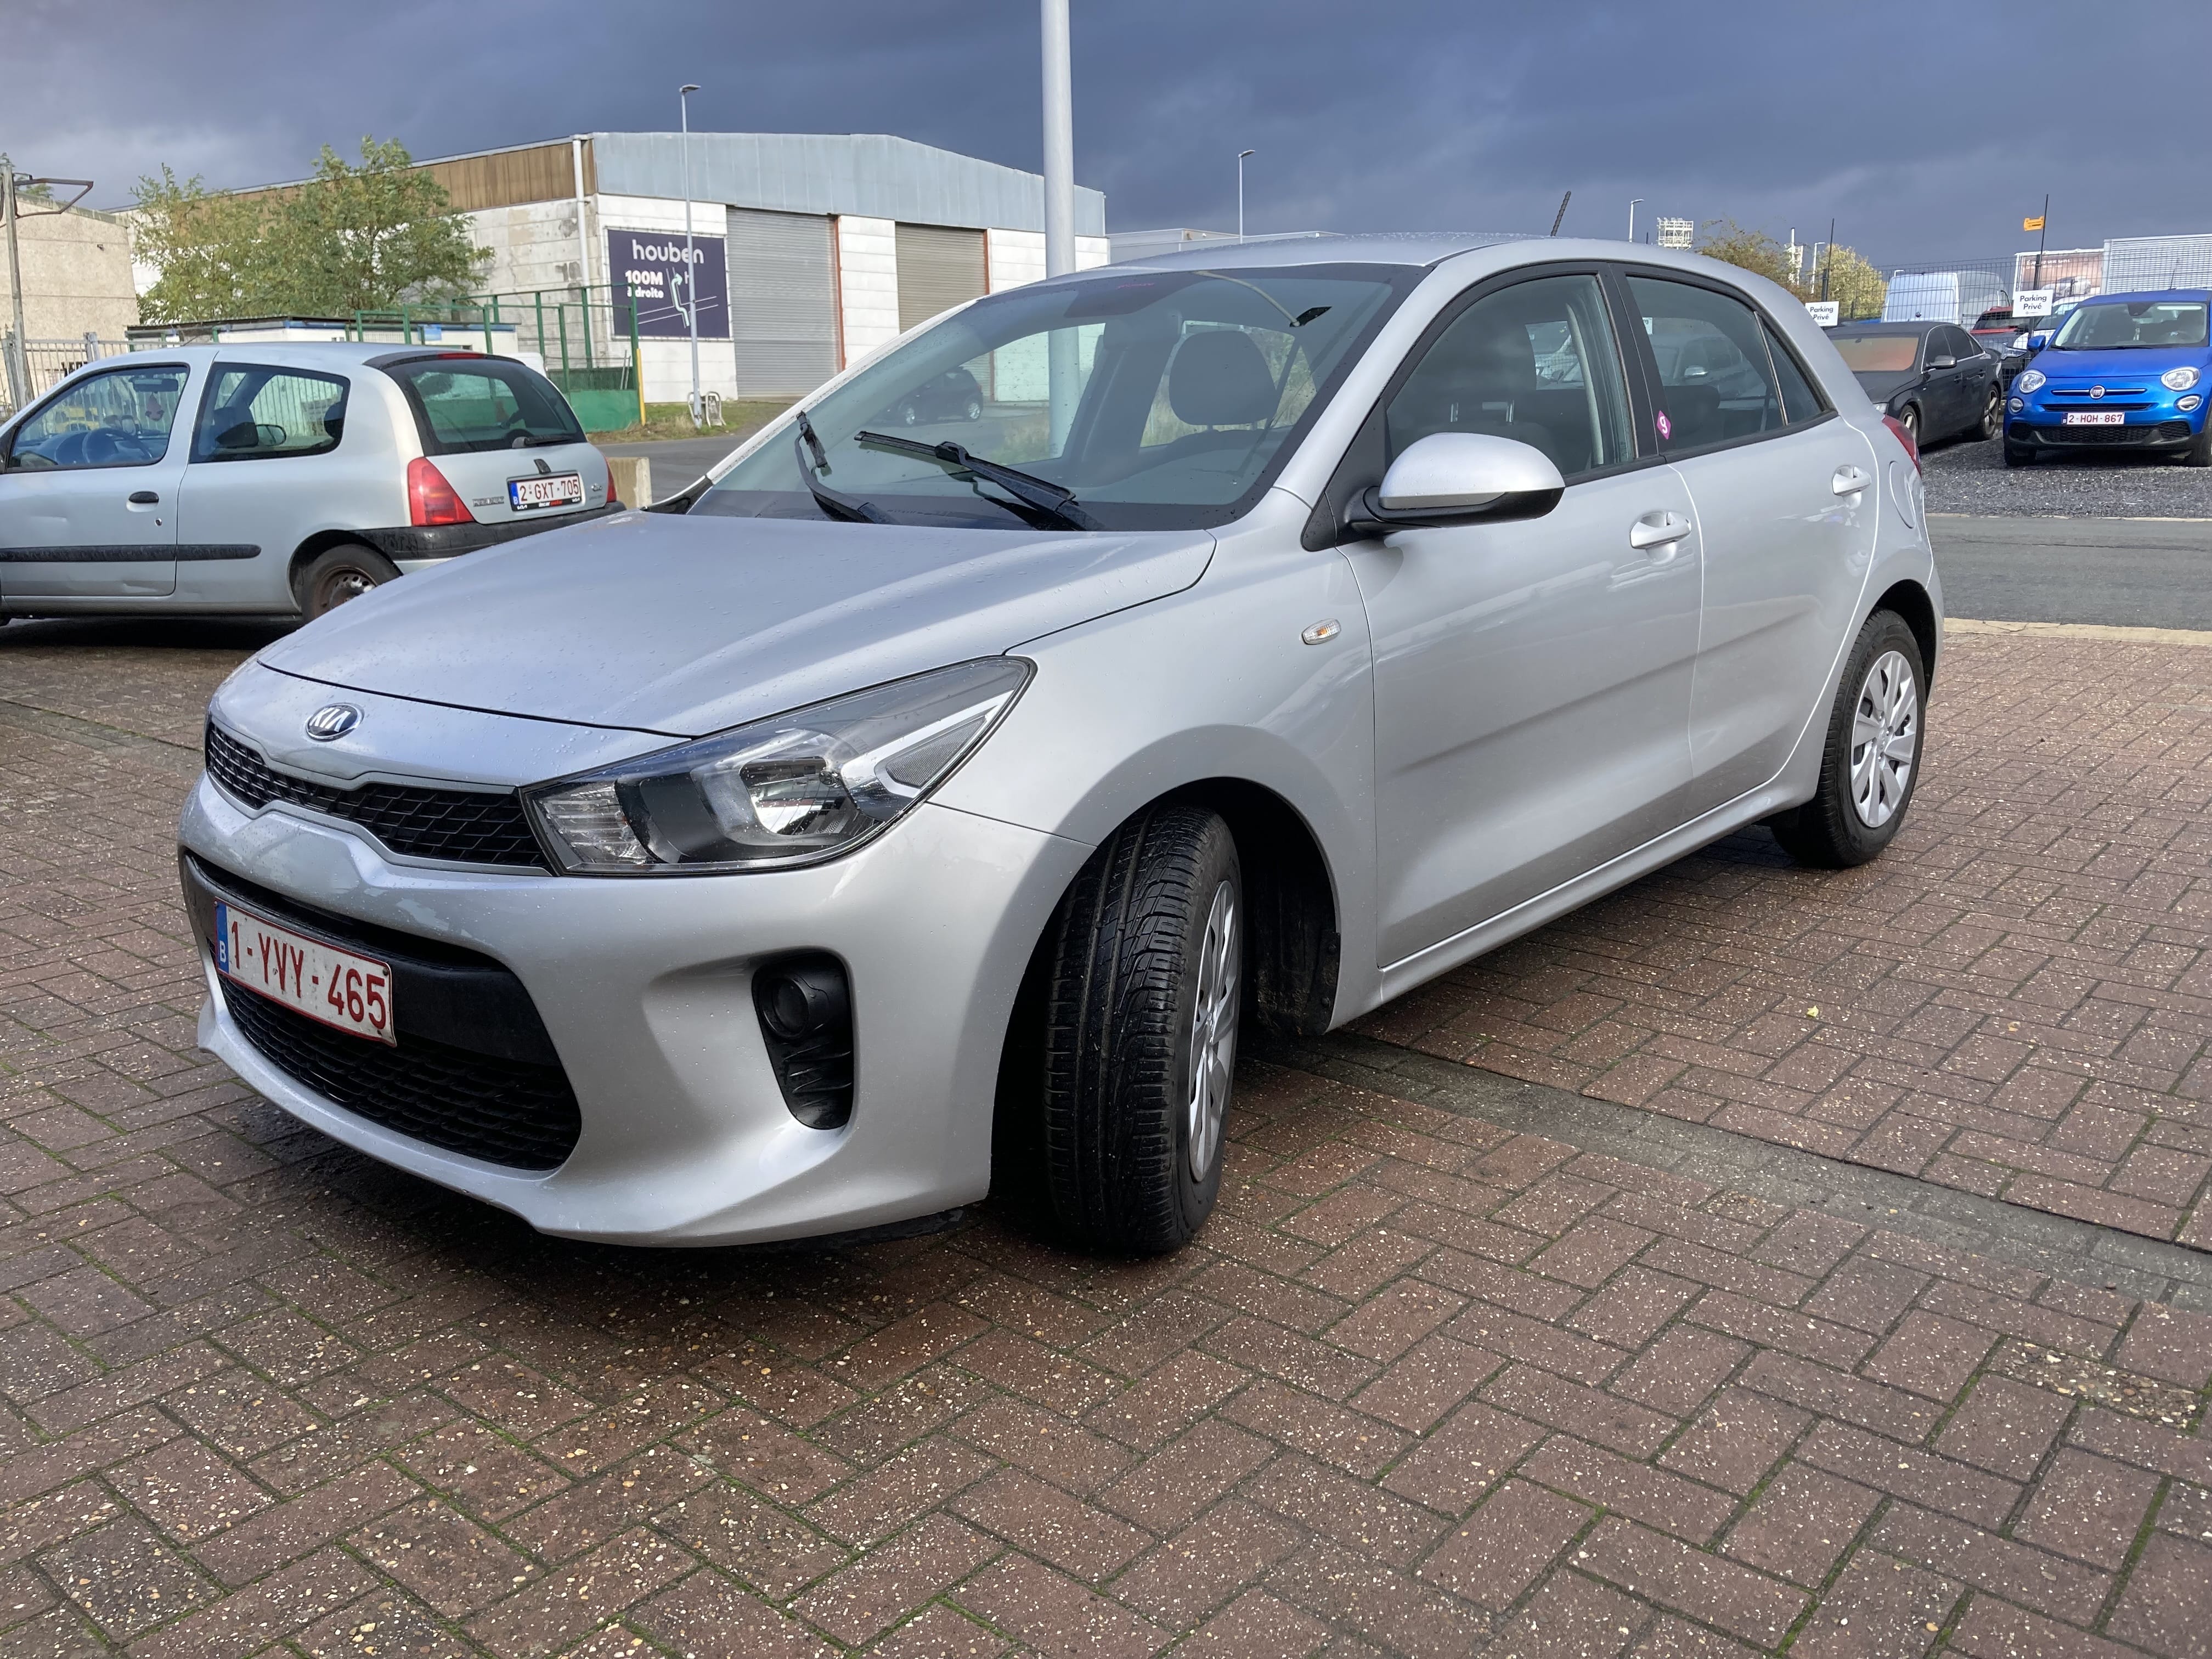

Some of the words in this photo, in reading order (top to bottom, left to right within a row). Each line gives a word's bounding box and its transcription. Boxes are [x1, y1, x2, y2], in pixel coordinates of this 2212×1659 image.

[632, 239, 704, 264] houben
[625, 270, 663, 285] 100M
[635, 286, 664, 298] droite
[2020, 294, 2047, 302] Parking
[219, 940, 227, 963] B
[230, 921, 387, 1030] 1-YVY-465
